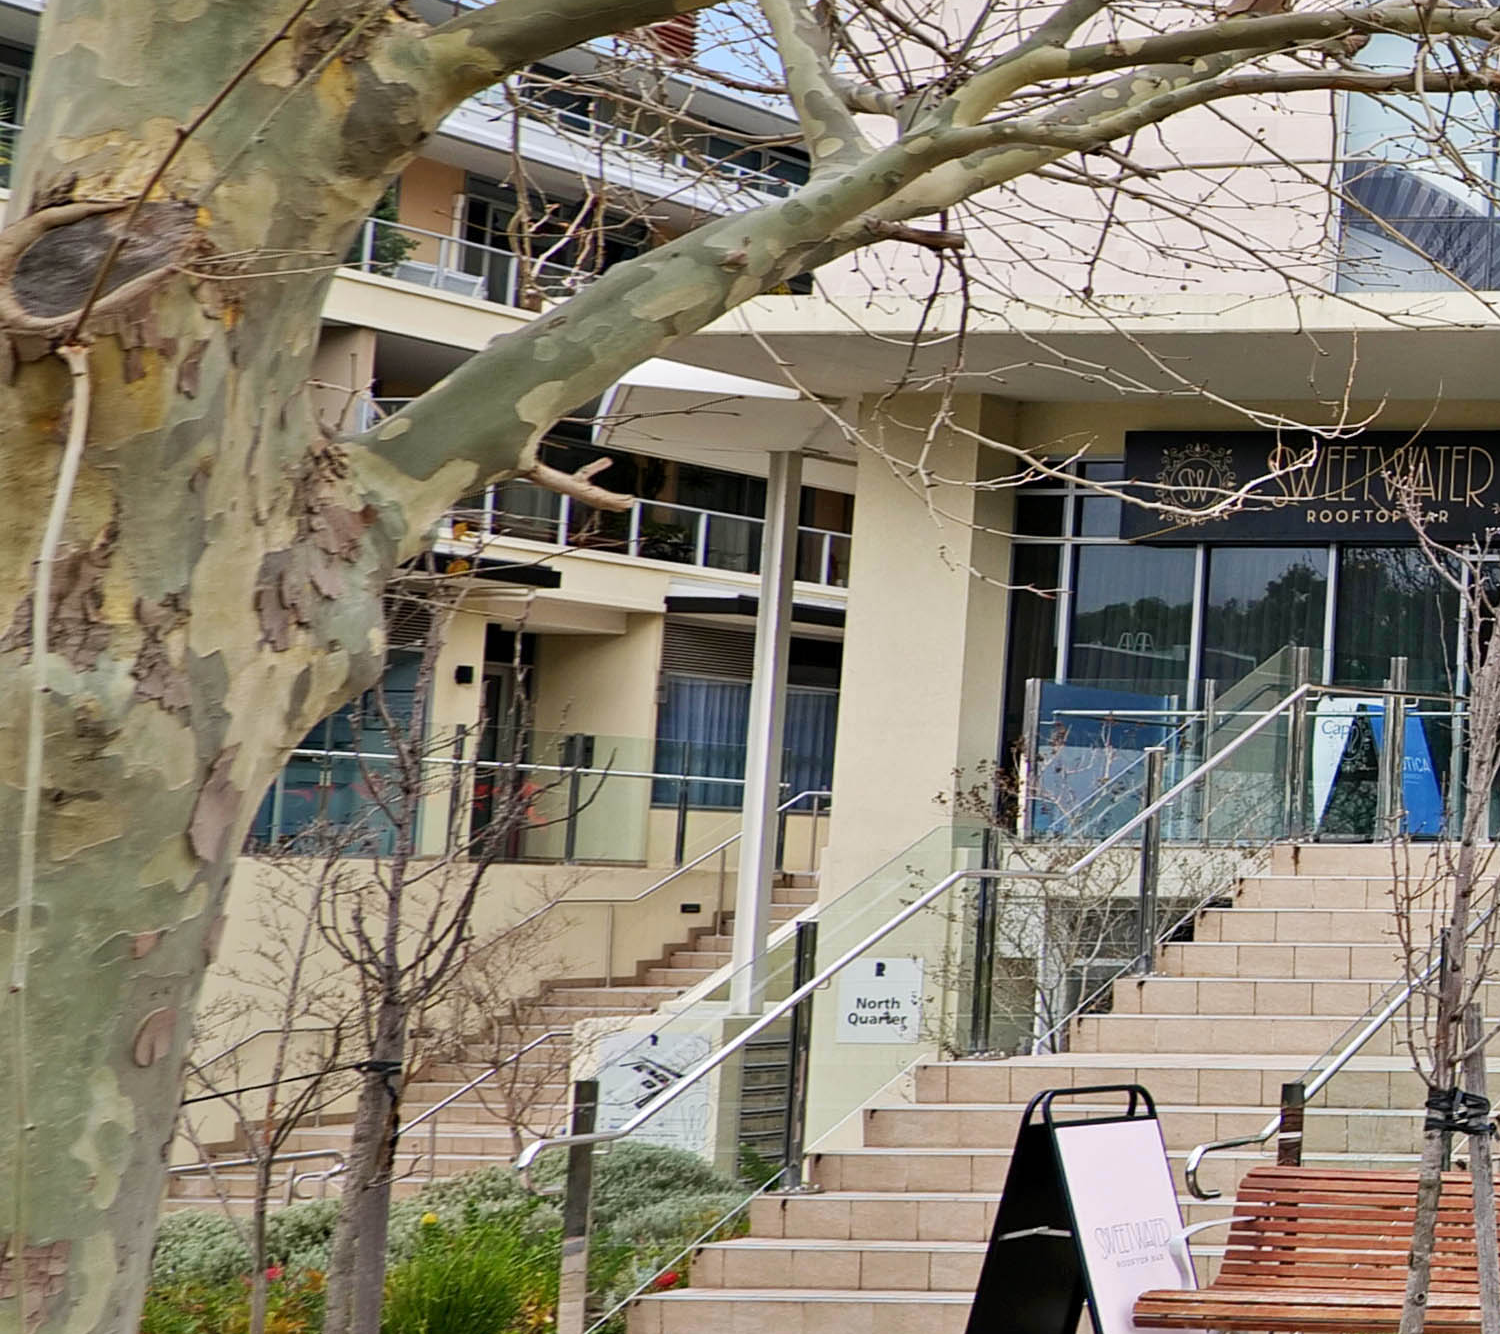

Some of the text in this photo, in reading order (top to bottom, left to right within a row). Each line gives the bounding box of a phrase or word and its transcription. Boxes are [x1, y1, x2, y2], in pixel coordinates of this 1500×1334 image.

[1267, 445, 1494, 508] SWEETWATER
[1306, 509, 1449, 524] ROOFTOP AR
[855, 997, 901, 1010] North
[847, 1012, 908, 1026] Quarter
